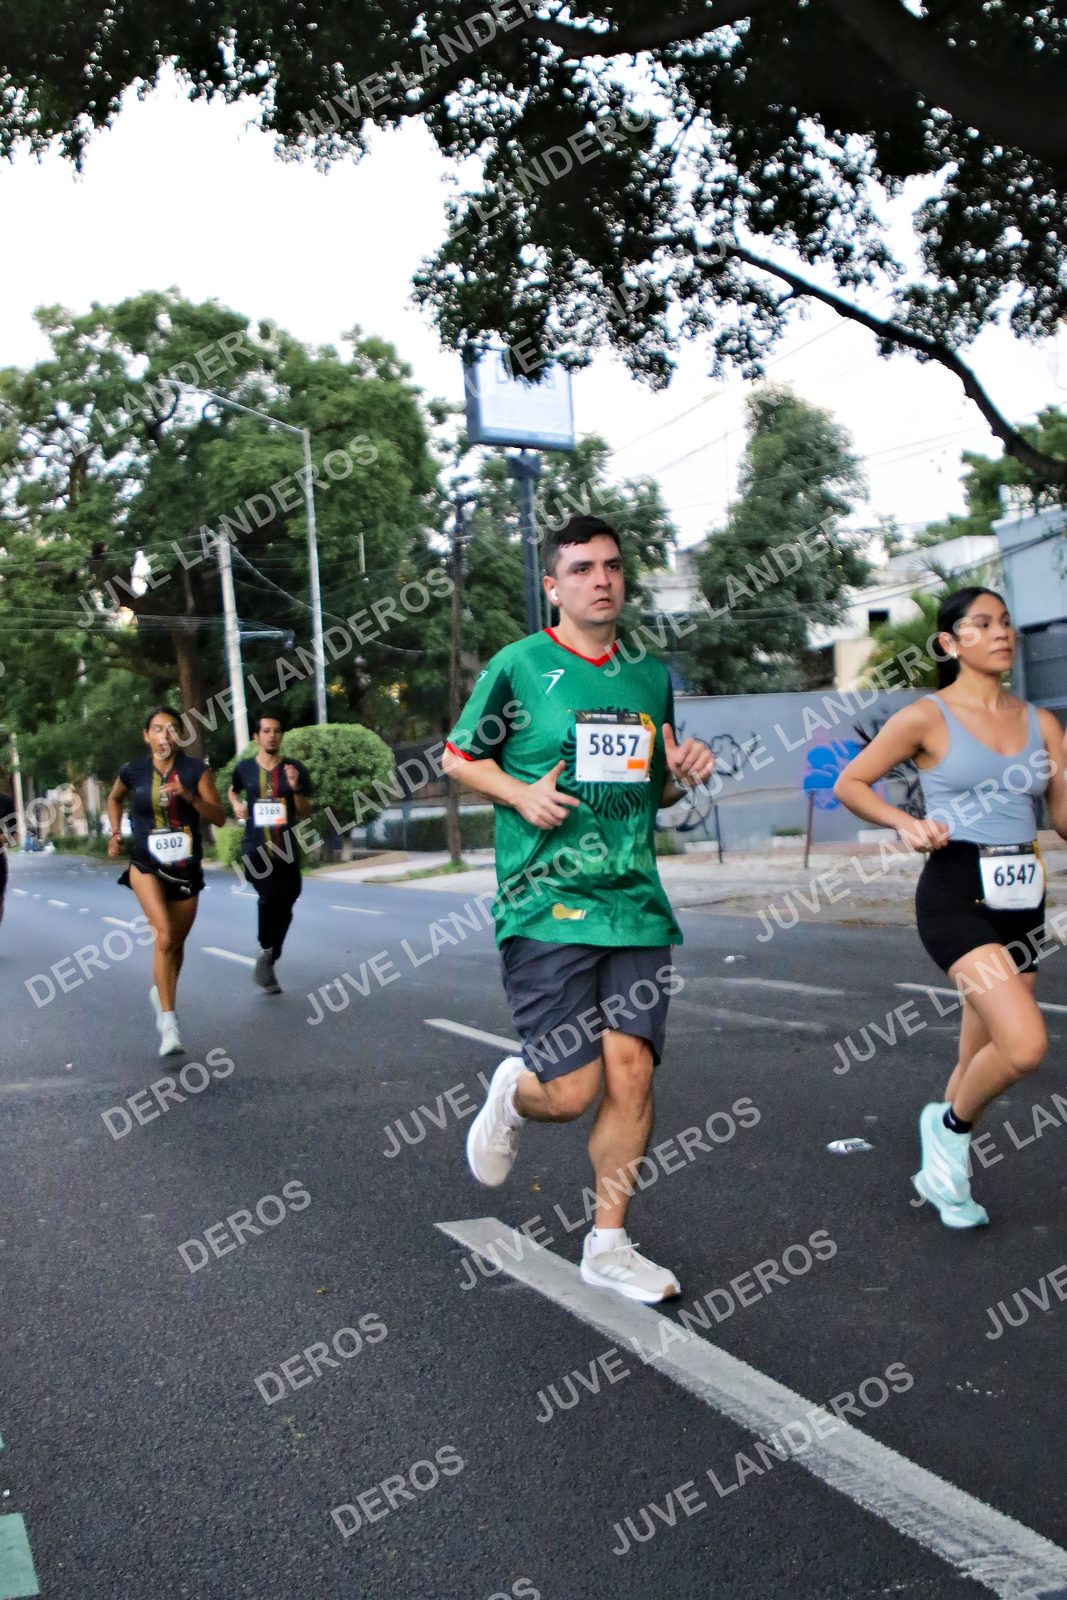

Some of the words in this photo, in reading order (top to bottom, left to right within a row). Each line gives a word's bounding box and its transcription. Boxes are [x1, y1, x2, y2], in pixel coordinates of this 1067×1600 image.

[588, 733, 640, 757] 5857
[155, 836, 183, 850] 6302
[994, 863, 1036, 887] 6547
